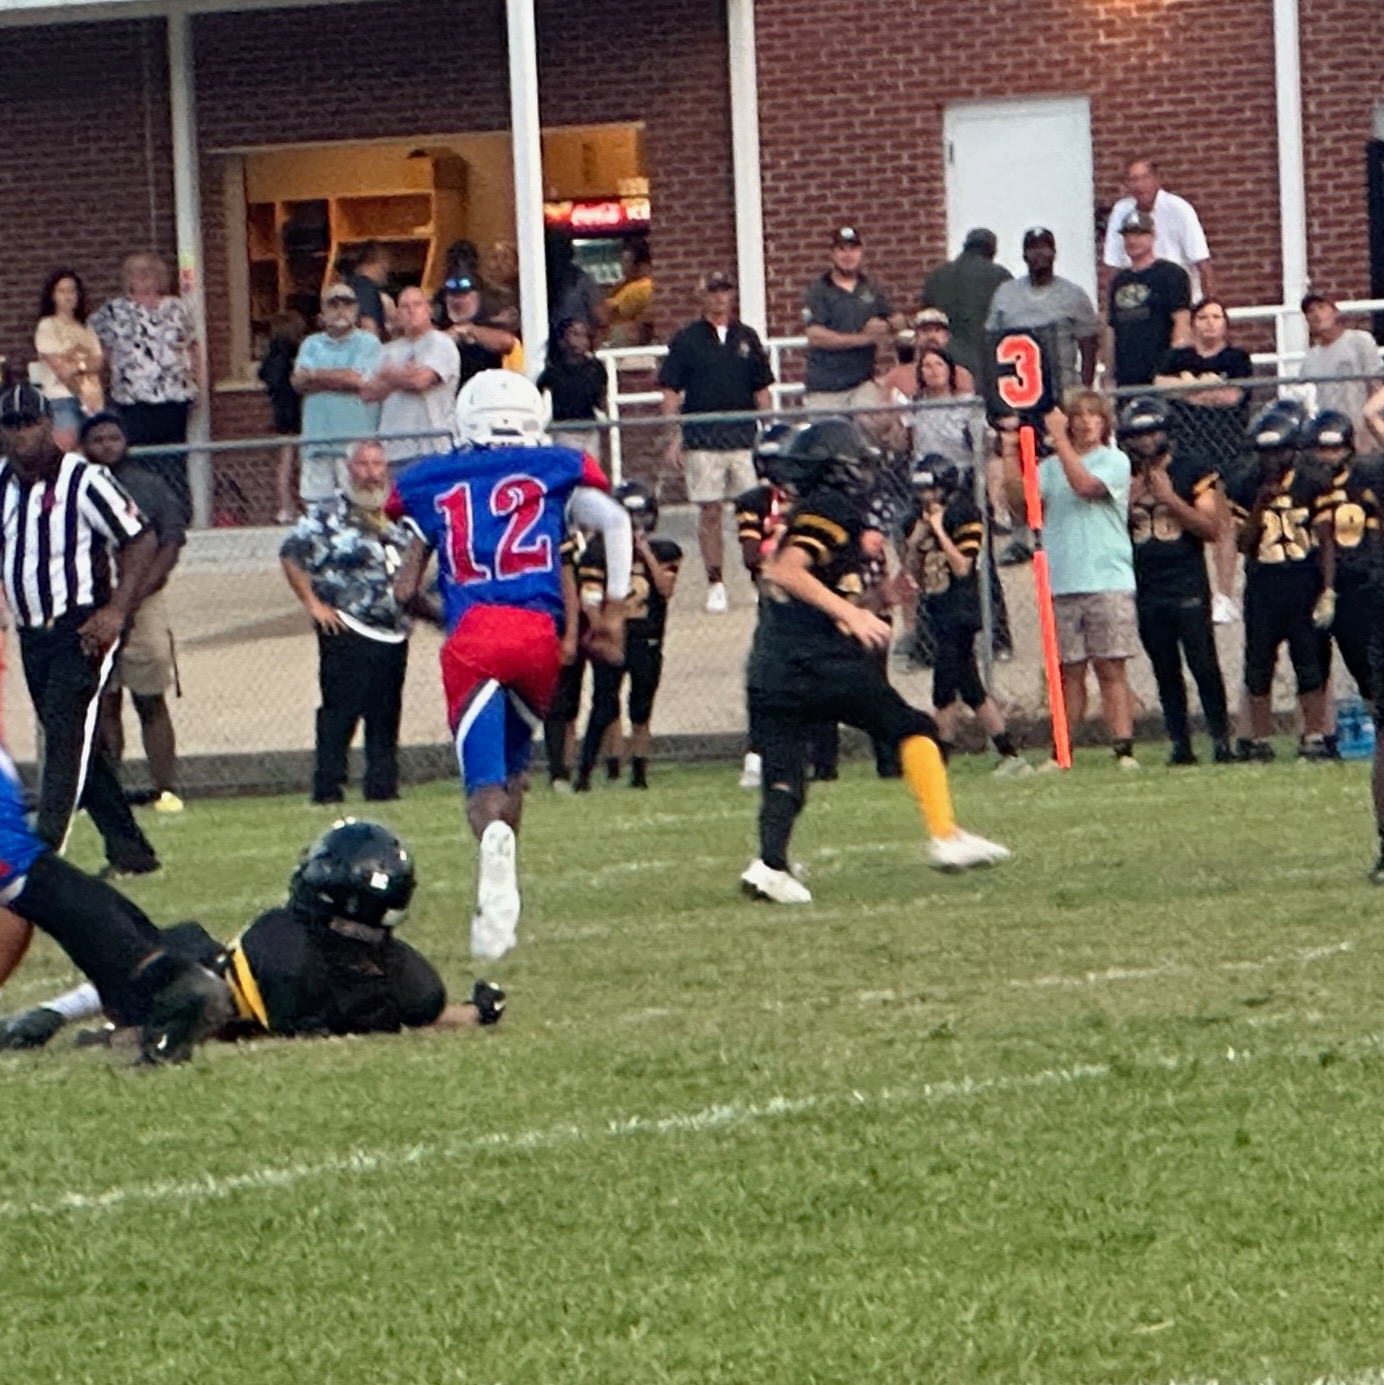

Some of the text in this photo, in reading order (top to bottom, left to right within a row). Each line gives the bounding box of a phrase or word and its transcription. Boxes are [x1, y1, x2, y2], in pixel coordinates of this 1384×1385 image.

[997, 335, 1042, 408] 3
[434, 474, 552, 586] 12
[1257, 507, 1309, 563] 25
